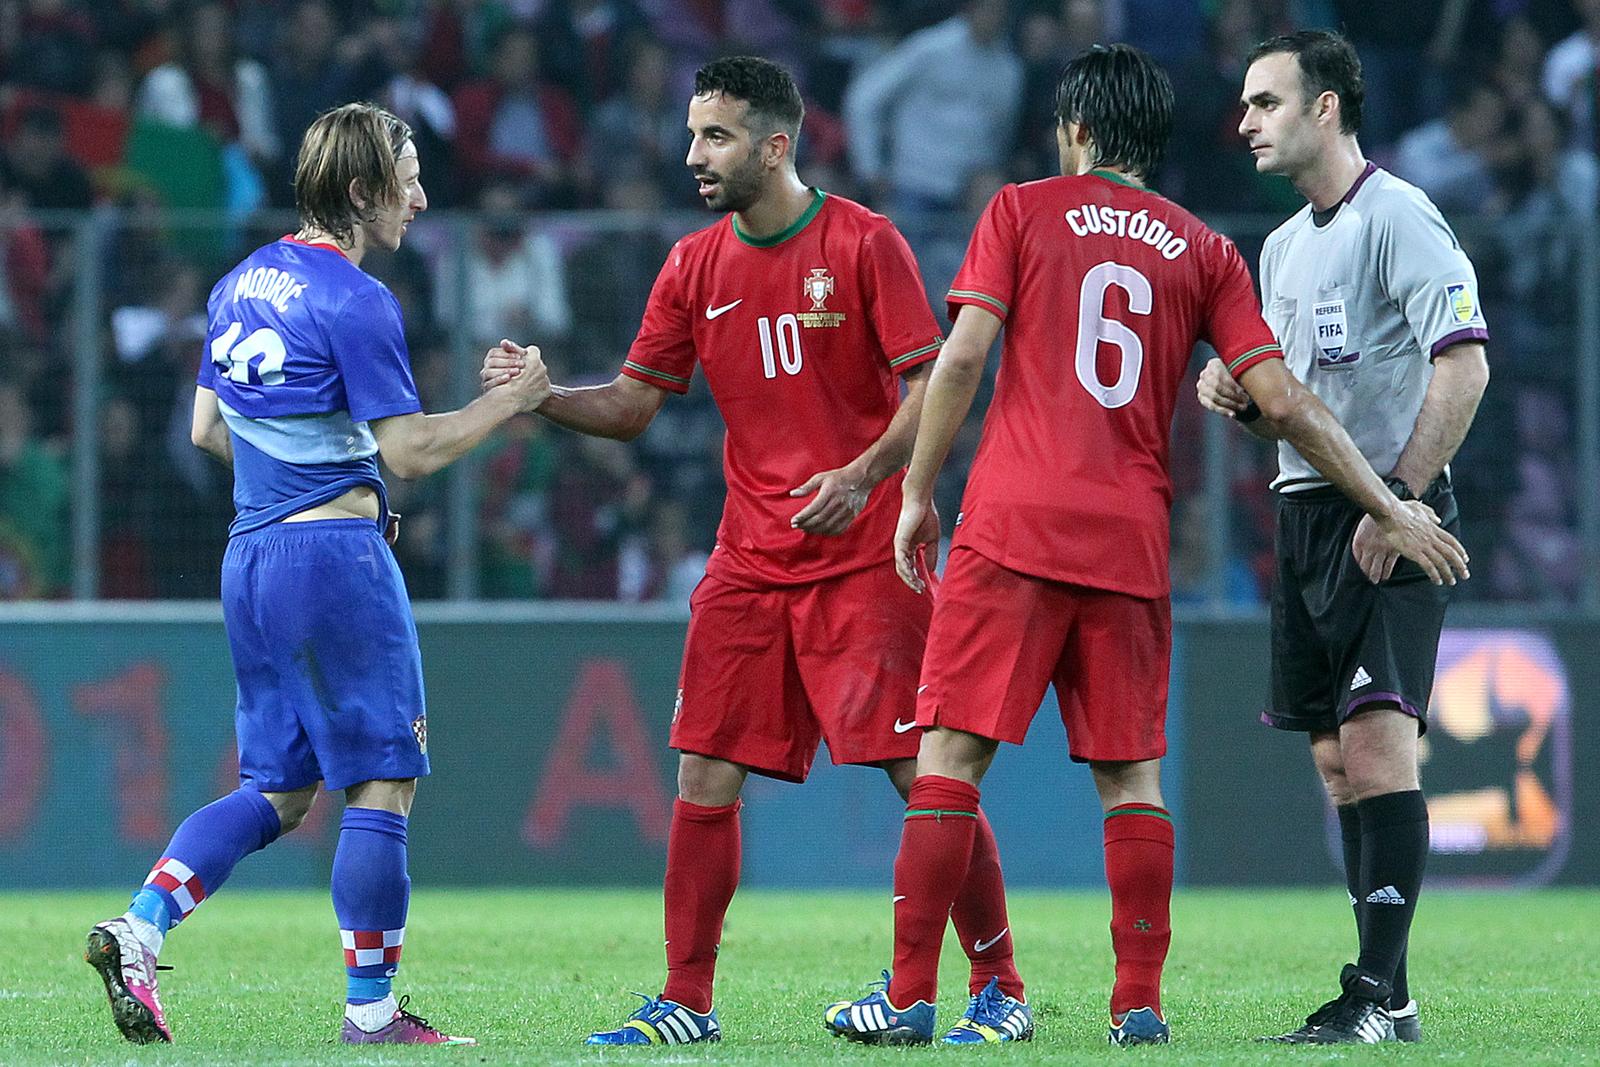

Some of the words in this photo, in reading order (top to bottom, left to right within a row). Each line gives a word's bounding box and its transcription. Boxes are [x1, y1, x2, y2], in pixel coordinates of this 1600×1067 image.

[1065, 204, 1187, 260] CUSTÓDIO
[233, 267, 308, 313] MODRIĆ
[1315, 304, 1343, 315] REFEREE
[211, 322, 287, 386] 10
[757, 313, 803, 379] 10
[1075, 261, 1153, 409] 6
[1318, 323, 1344, 338] FIFA
